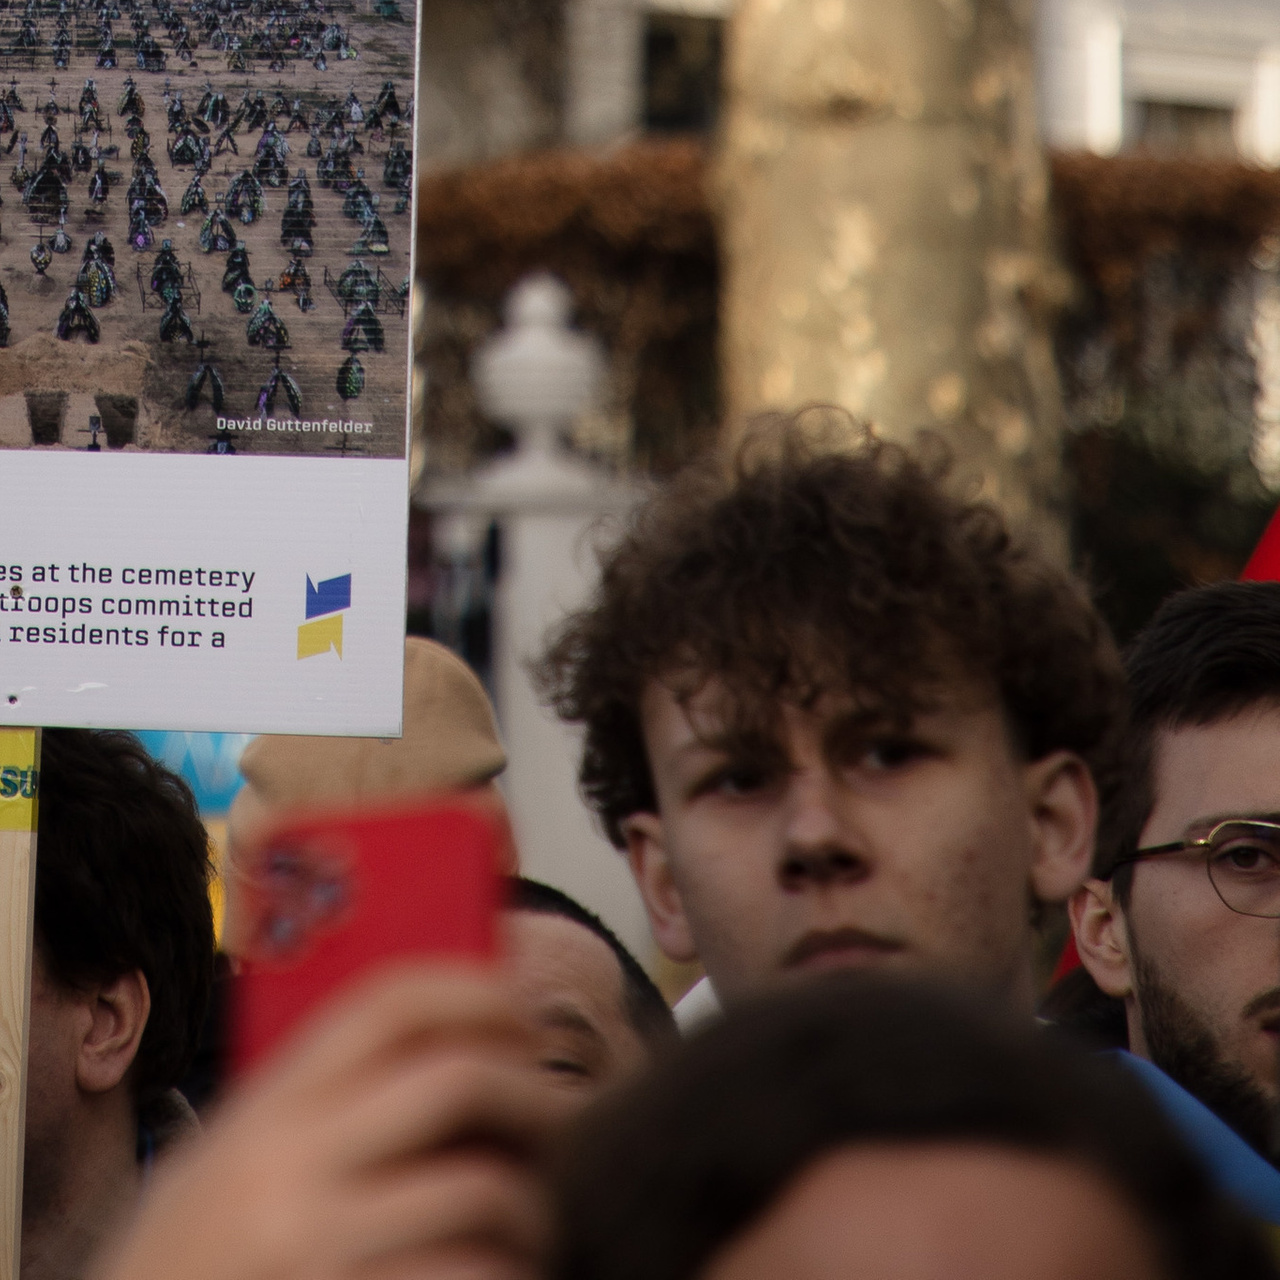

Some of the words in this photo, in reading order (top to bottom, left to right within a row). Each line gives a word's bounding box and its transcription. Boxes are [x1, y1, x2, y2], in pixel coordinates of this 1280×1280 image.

[216, 417, 262, 431] David
[266, 418, 373, 433] Guttenfelder
[31, 563, 62, 583] at
[68, 562, 113, 584] the
[121, 568, 256, 593] cemetery
[101, 595, 253, 618] committed
[9, 622, 149, 646] residents
[157, 625, 203, 647] for
[211, 631, 225, 648] a
